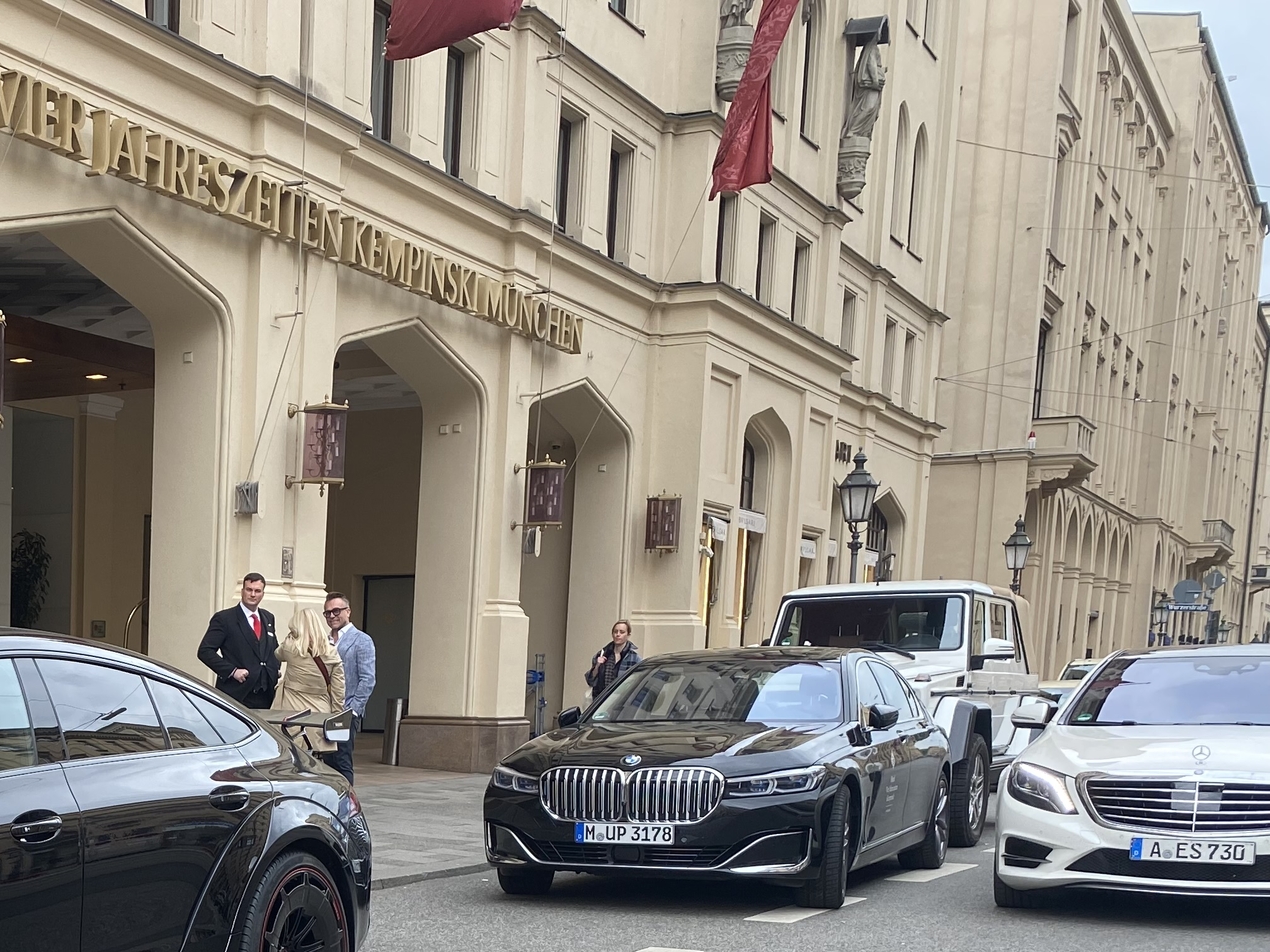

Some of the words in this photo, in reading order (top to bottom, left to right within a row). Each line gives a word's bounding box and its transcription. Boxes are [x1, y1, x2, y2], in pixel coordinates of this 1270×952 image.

[85, 108, 342, 261] JAHRESZEITEN
[340, 213, 481, 316] KEMPINSKI
[477, 272, 584, 355] MÜNCHEN
[585, 825, 596, 841] M
[605, 825, 627, 841] UP
[631, 826, 673, 842] 3178
[1149, 841, 1162, 858] A
[1175, 842, 1202, 860] ES
[1207, 843, 1246, 861] 730
